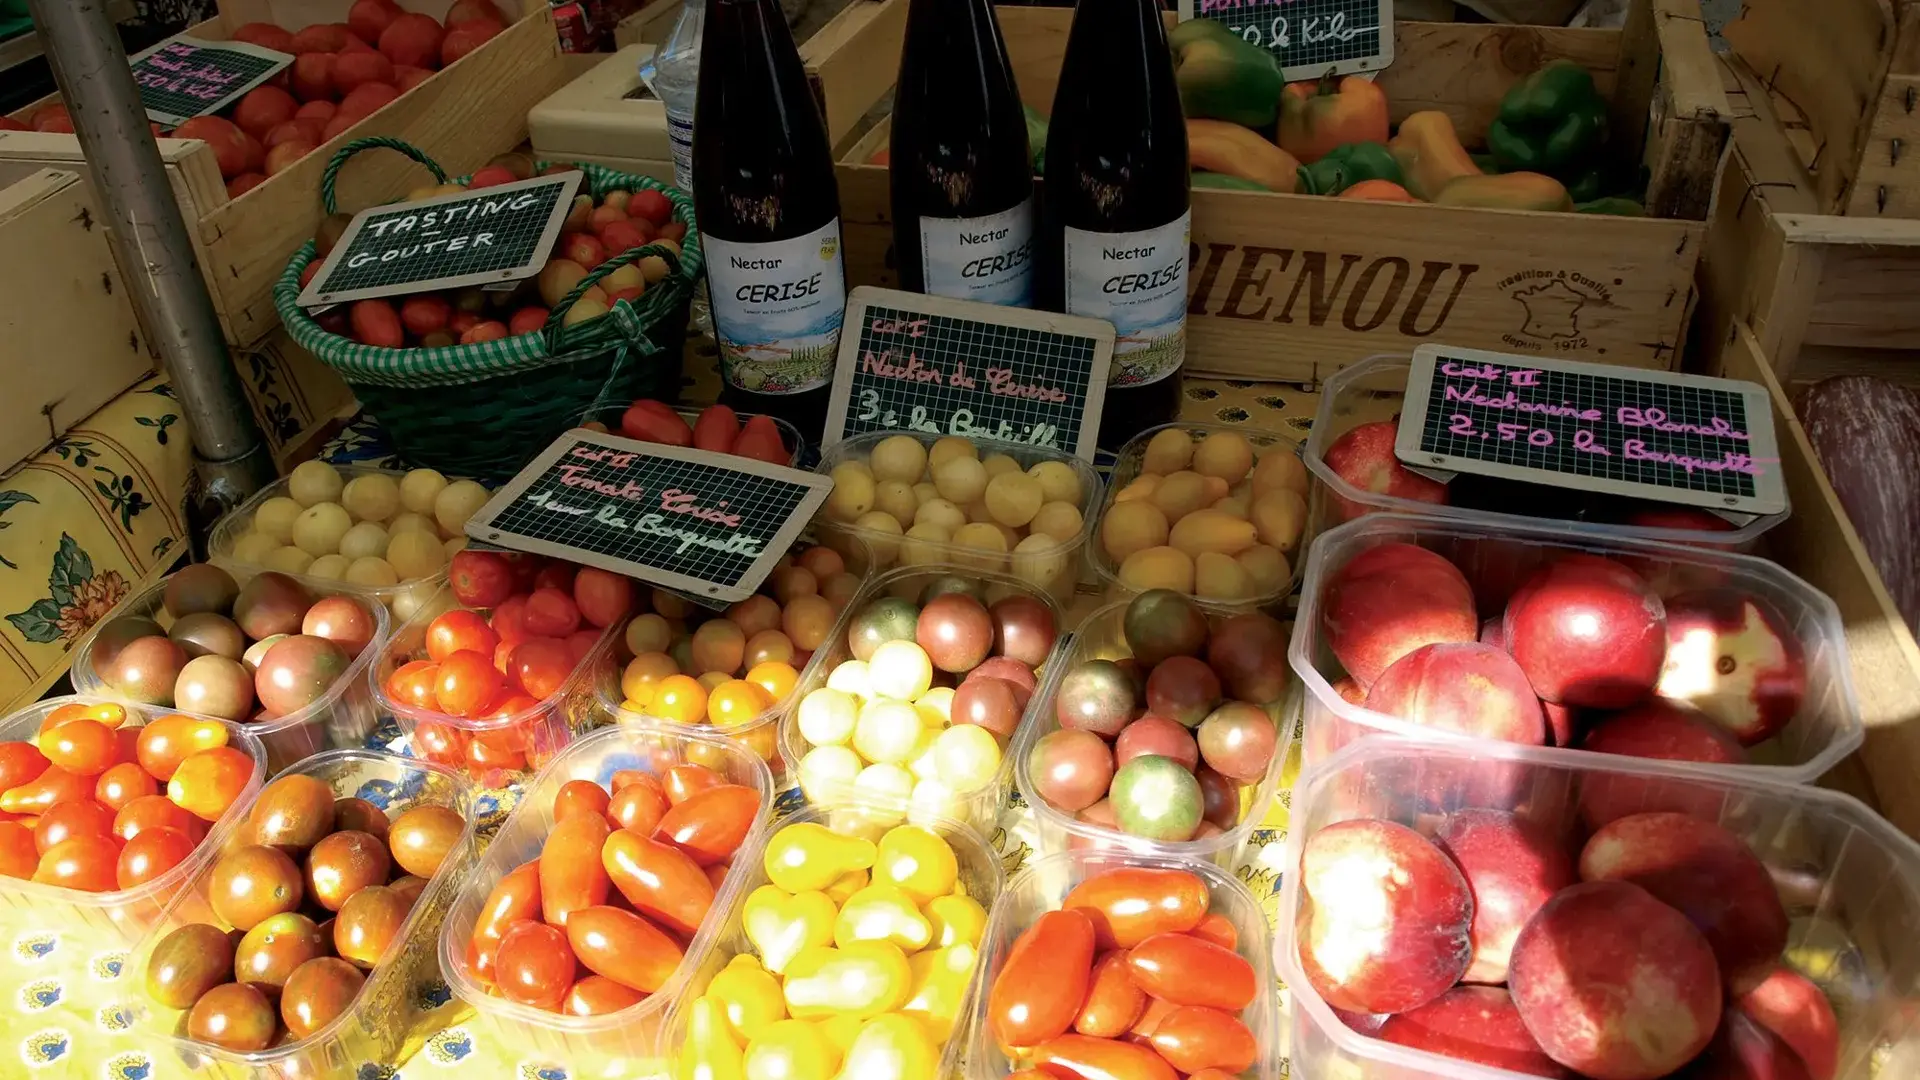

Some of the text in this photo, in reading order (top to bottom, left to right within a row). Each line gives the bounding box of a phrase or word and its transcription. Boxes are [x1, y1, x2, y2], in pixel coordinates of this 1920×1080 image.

[1302, 12, 1387, 48] Kilo
[348, 232, 494, 268] GOUTER
[960, 228, 1009, 246] Nectar
[731, 256, 782, 271] Nectar
[961, 241, 1036, 278] CERISE
[1103, 246, 1156, 260] Nectar
[735, 272, 822, 303] CERISE
[1103, 257, 1184, 294] CERISE
[1556, 269, 1567, 280] &
[1501, 333, 1589, 351] depuis 1972
[1445, 384, 1751, 441] Nectarine Blanche
[1572, 429, 1613, 457] la
[660, 488, 742, 528] Cerise
